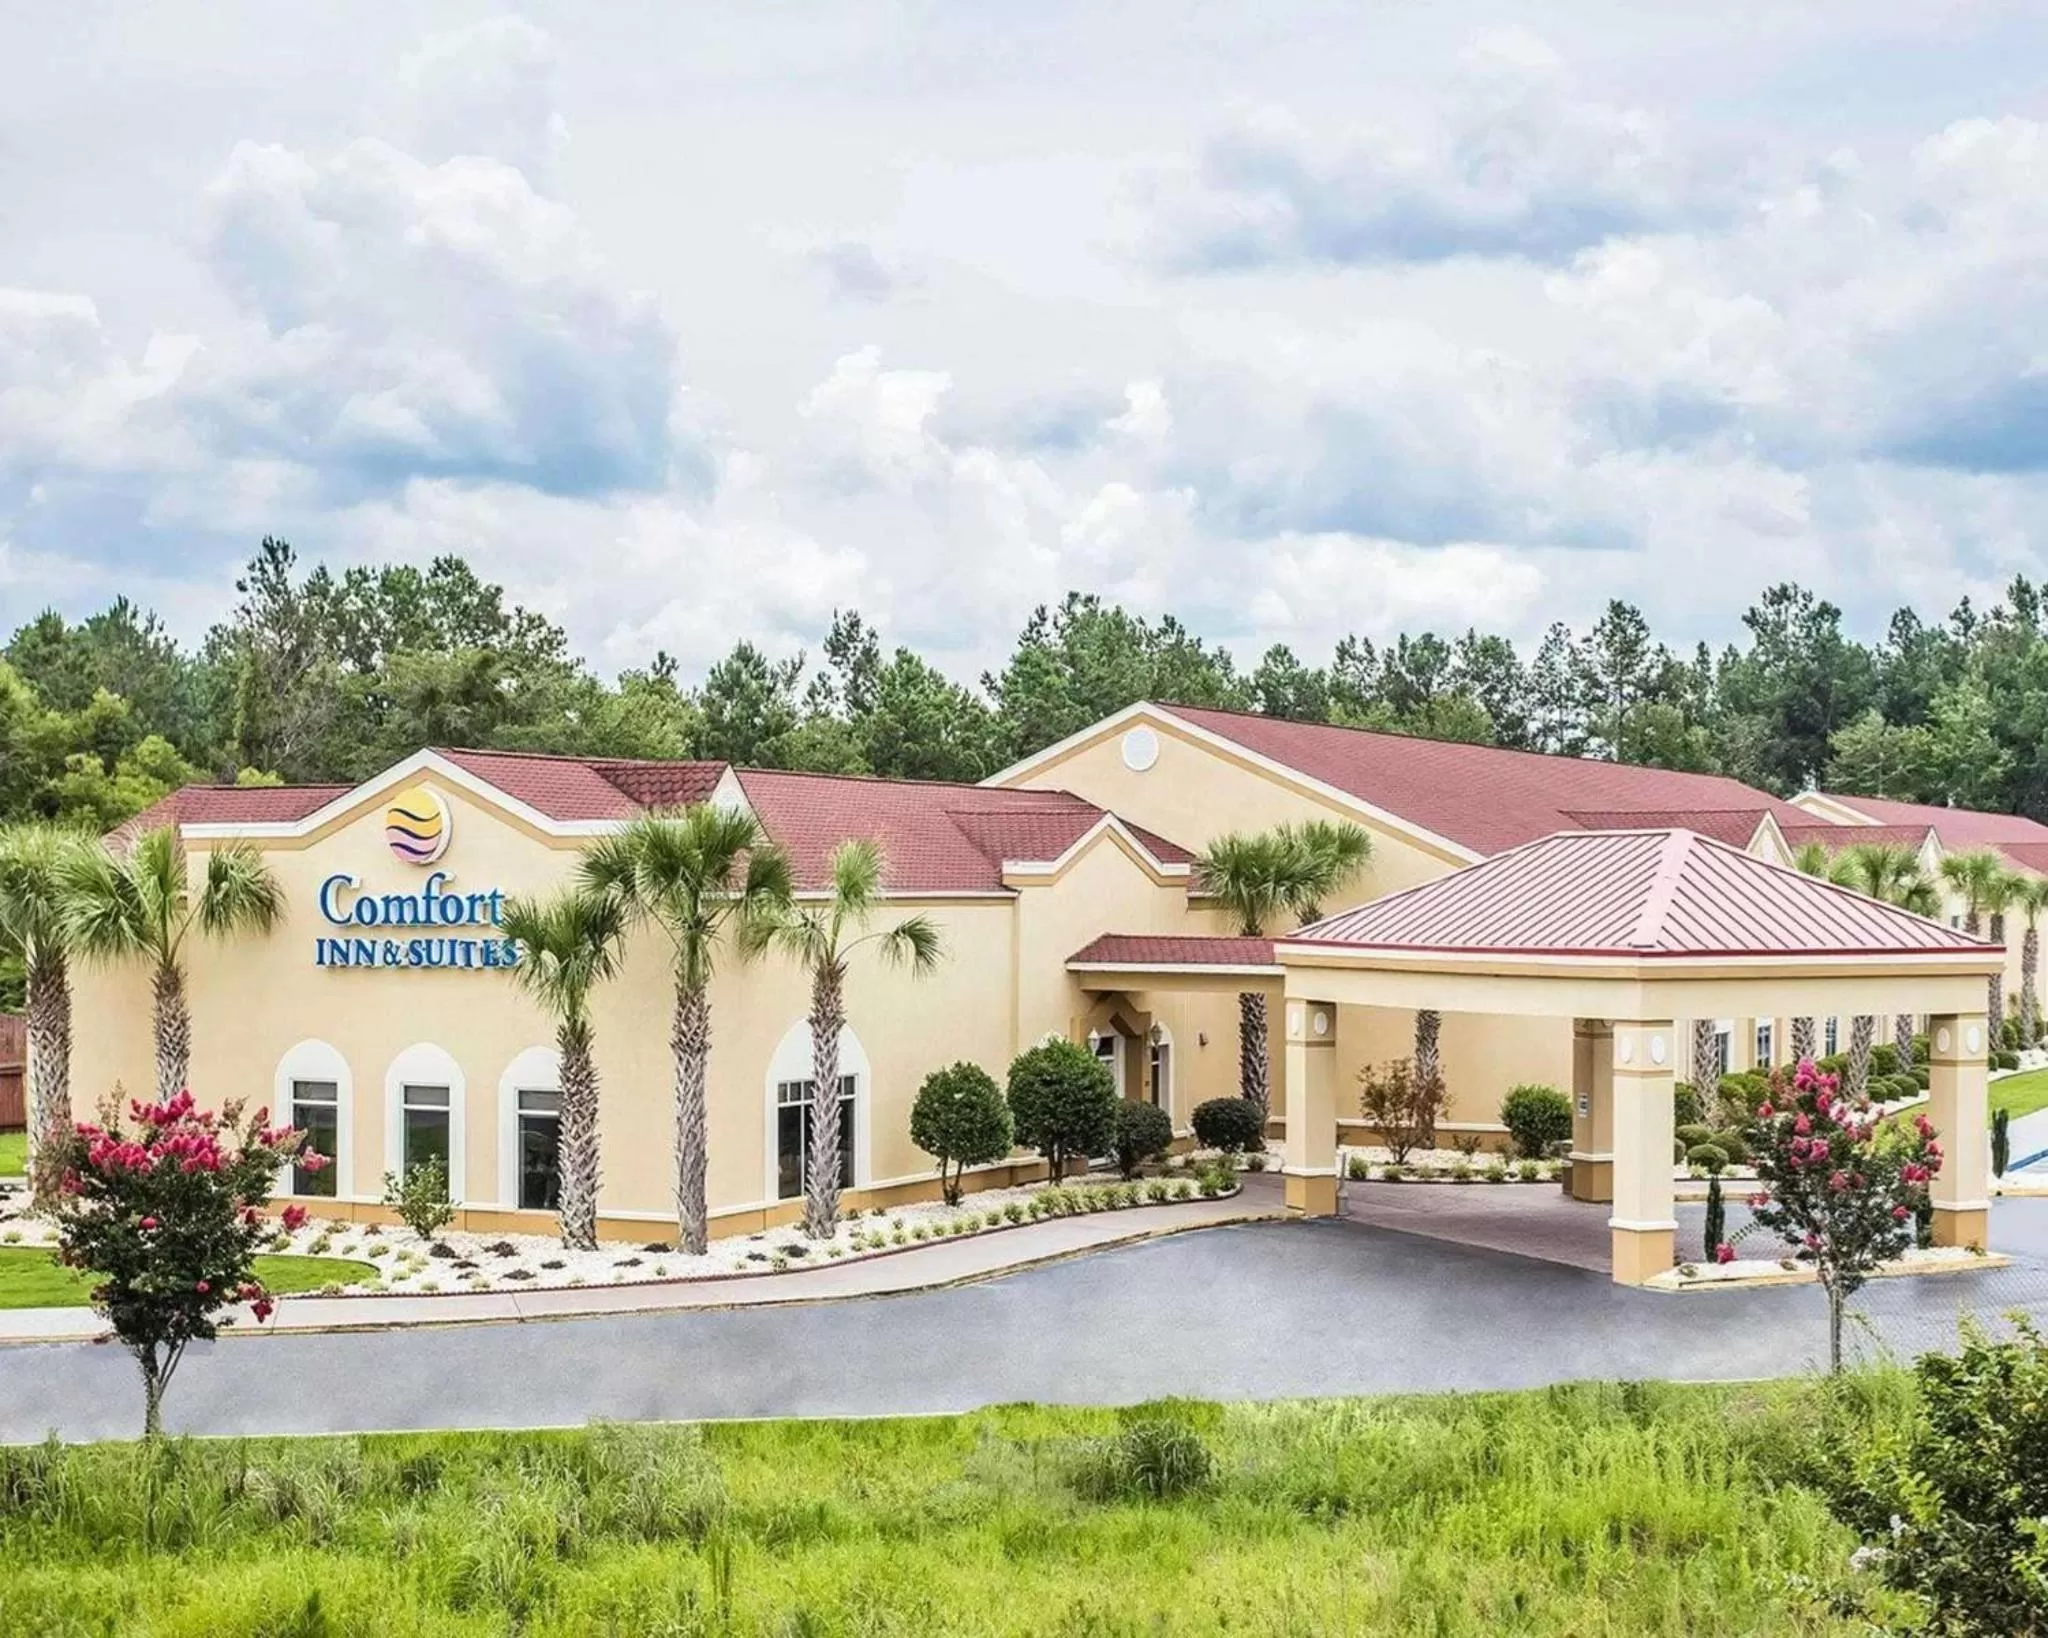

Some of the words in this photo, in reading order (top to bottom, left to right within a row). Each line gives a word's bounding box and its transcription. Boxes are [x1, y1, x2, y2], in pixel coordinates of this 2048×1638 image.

[319, 872, 505, 926] Comfort
[316, 938, 377, 966] INN
[383, 940, 402, 966] &
[408, 938, 518, 967] SUITES
